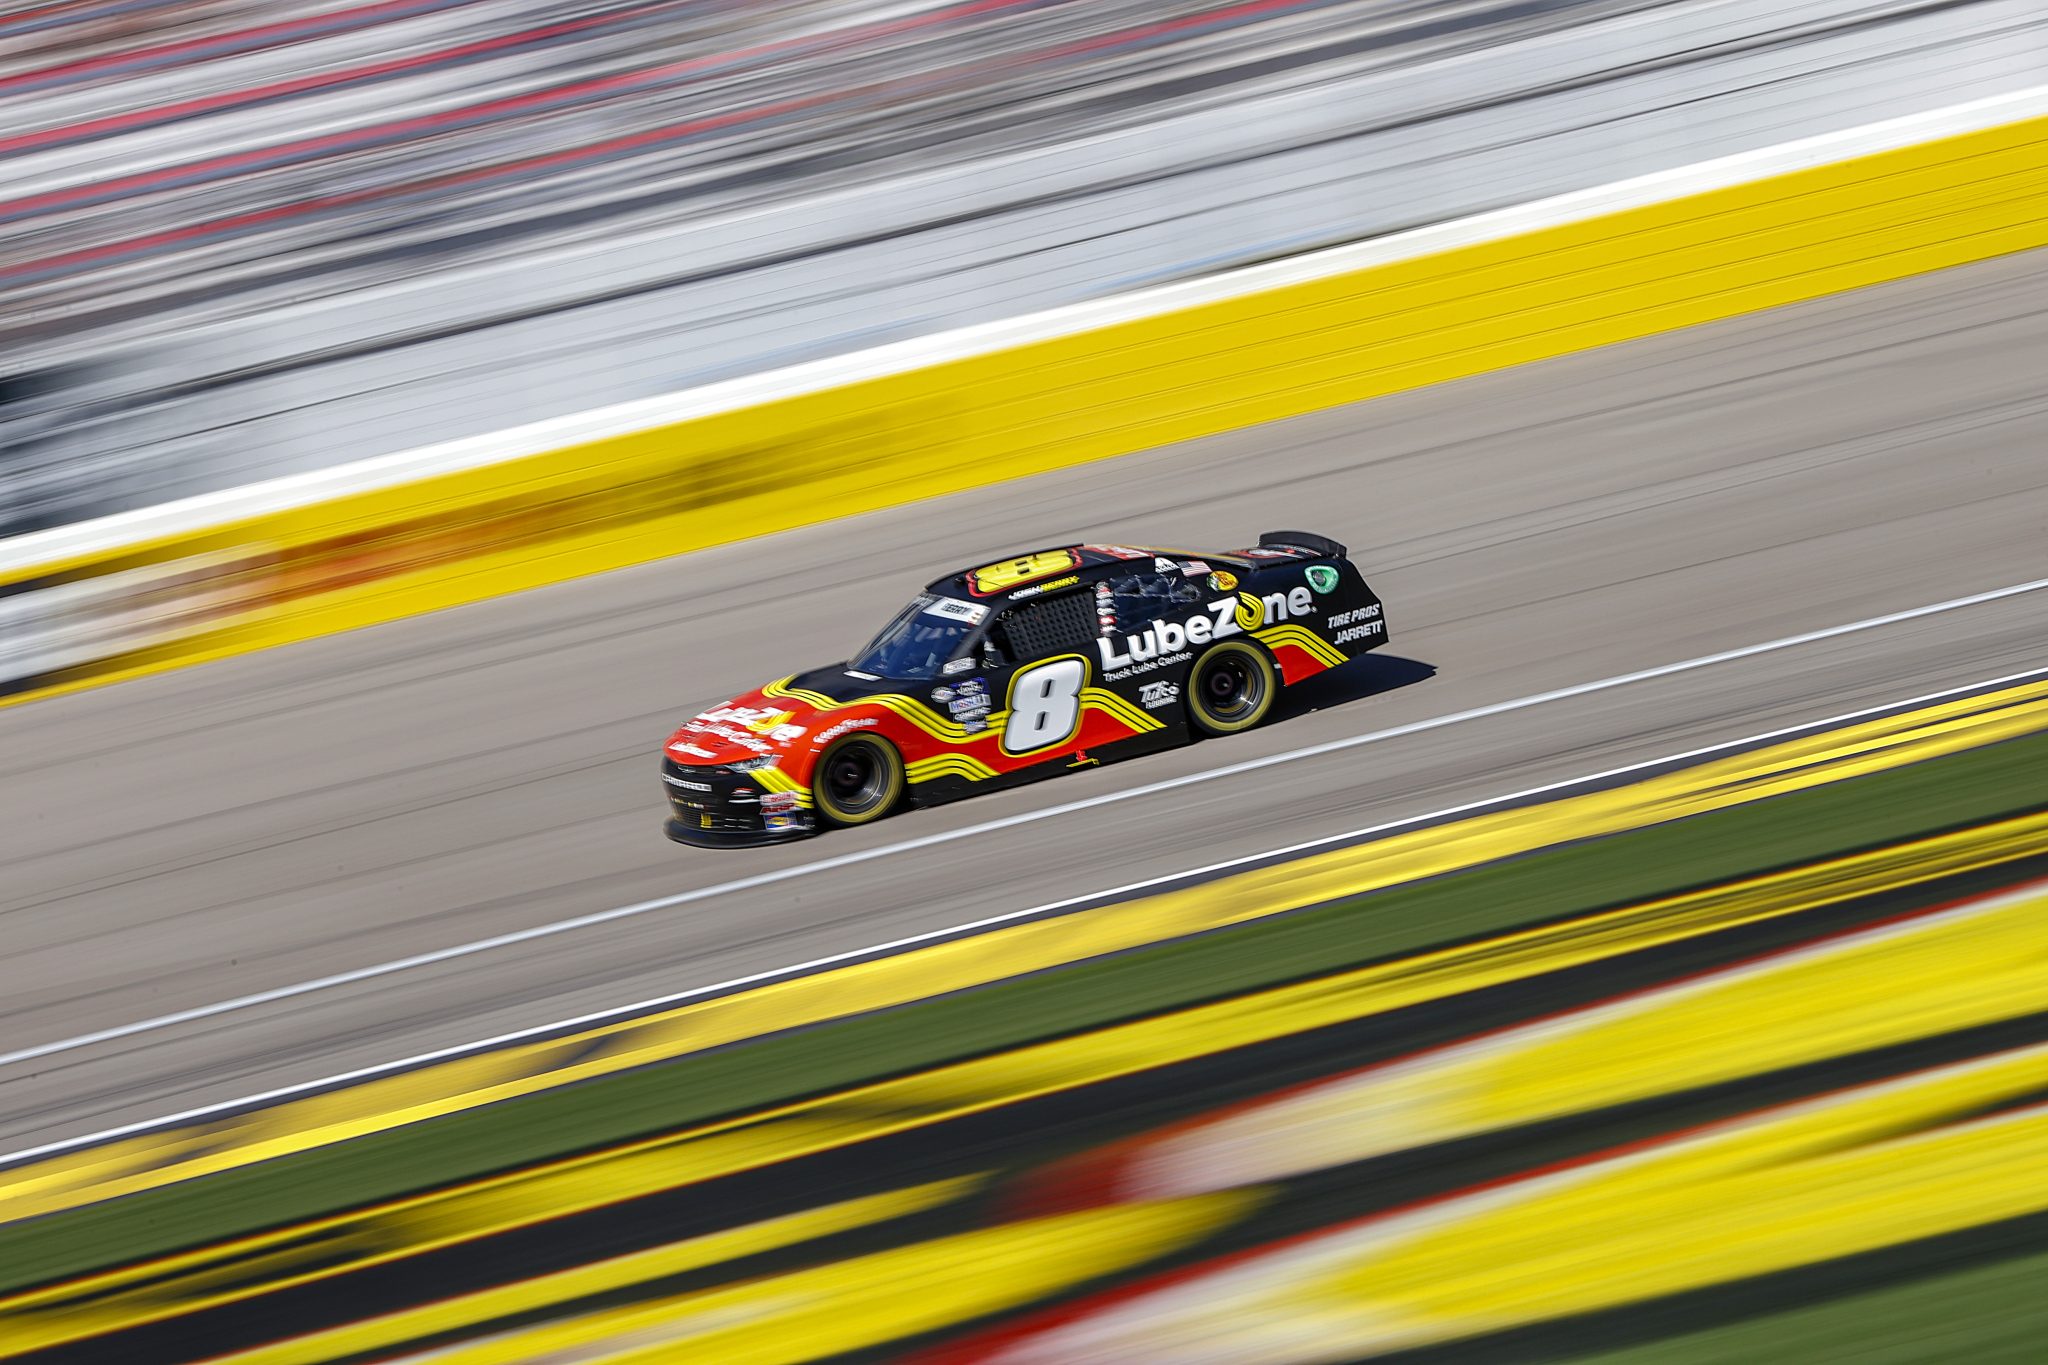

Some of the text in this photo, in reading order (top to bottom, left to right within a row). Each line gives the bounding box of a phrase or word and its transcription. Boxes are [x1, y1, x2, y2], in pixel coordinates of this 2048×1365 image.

[1096, 586, 1313, 671] LubeZone
[1327, 602, 1380, 629] TIRE PROS
[1333, 620, 1383, 645] JARRETT
[1102, 651, 1194, 683] Truck Lube Center
[1003, 659, 1085, 751] 8
